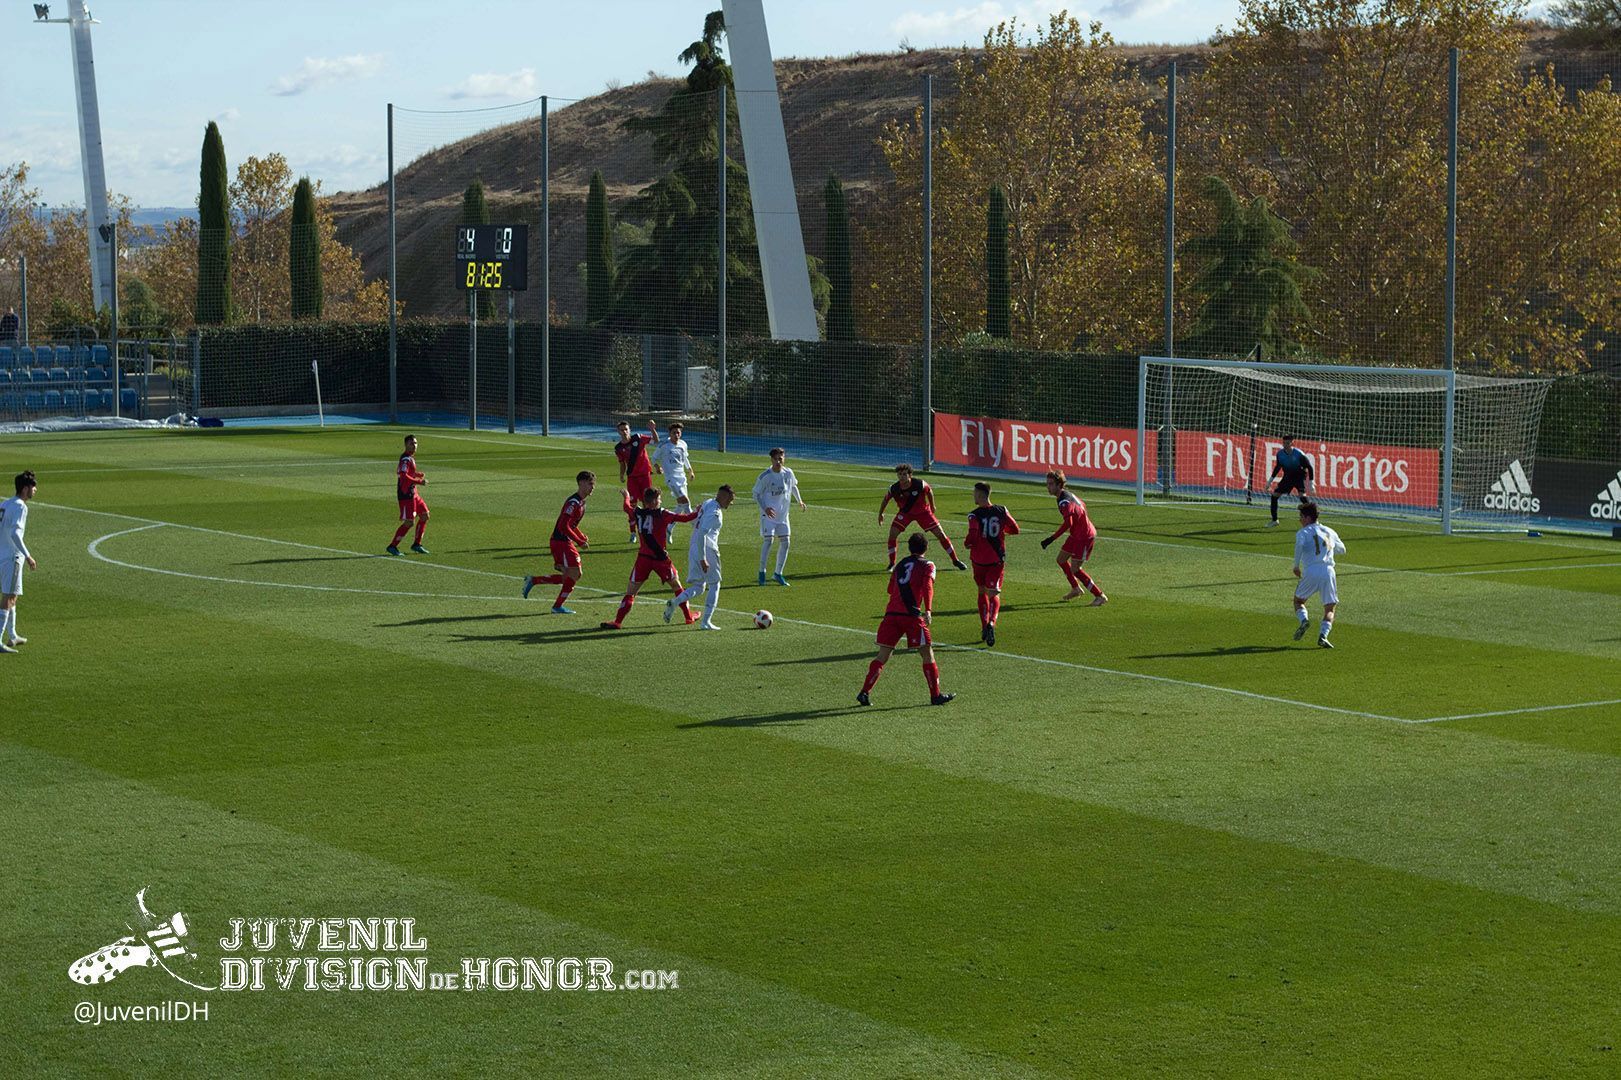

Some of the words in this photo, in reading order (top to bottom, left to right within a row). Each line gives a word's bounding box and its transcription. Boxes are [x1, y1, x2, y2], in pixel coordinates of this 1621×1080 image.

[467, 229, 476, 251] 4
[503, 228, 512, 253] 0
[466, 262, 502, 288] 81:25
[960, 419, 1004, 467] Fly
[1011, 424, 1132, 471] Emirates
[1484, 492, 1540, 513] adidas
[635, 514, 654, 534] 14
[982, 516, 1000, 538] 16
[899, 562, 914, 584] 3
